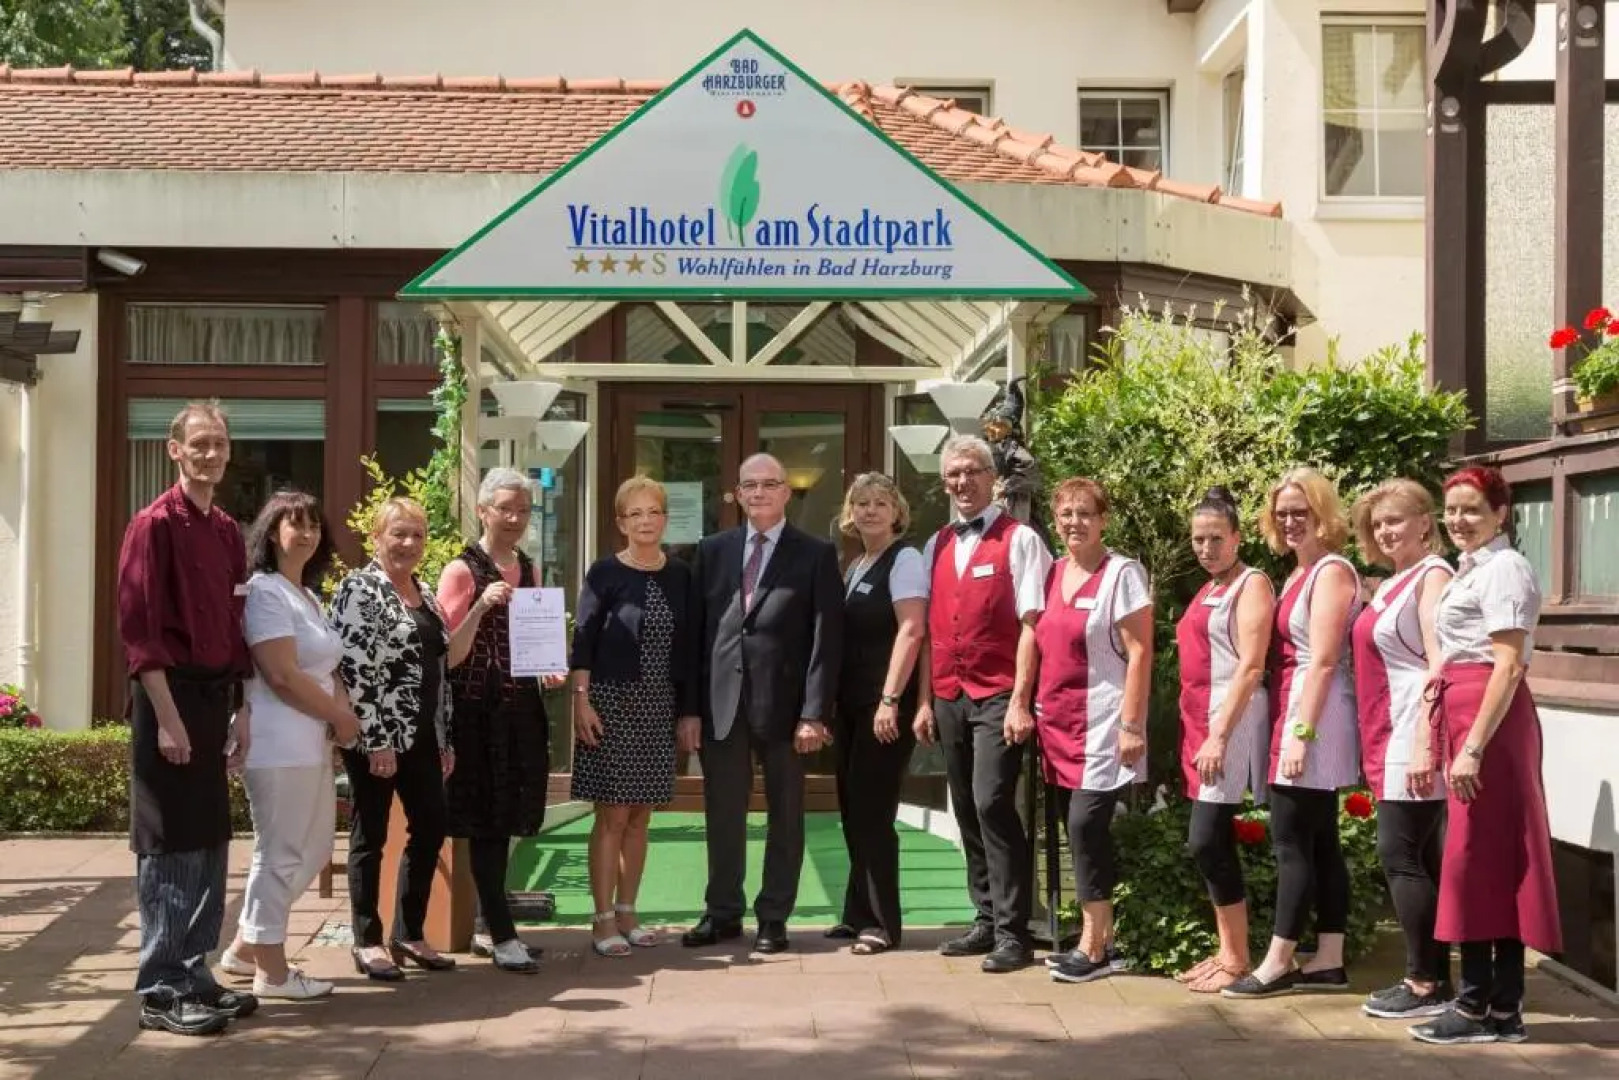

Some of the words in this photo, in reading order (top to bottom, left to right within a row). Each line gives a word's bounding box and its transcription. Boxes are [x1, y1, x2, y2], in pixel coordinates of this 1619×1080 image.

[730, 59, 758, 74] BAD
[702, 75, 785, 90] HARZBURGER
[567, 204, 716, 246] Vitalhotel
[755, 219, 799, 246] am
[807, 203, 952, 254] Stadtpark
[678, 257, 785, 281] Wohlfühlen
[793, 258, 811, 276] in
[818, 258, 856, 276] Bad
[861, 258, 954, 280] Harzburg
